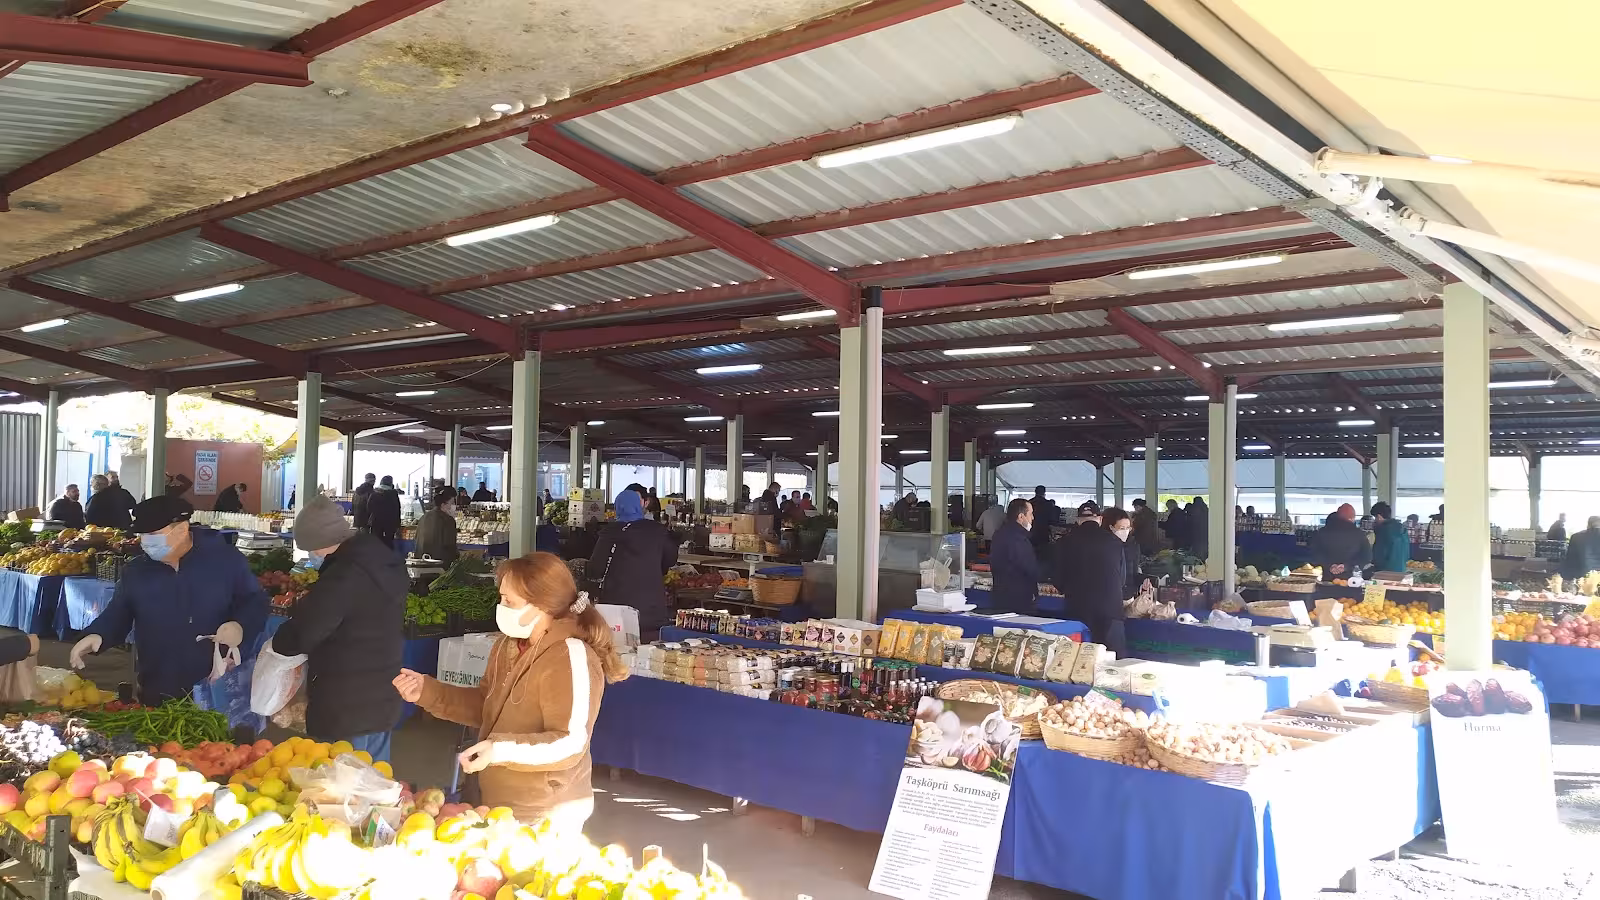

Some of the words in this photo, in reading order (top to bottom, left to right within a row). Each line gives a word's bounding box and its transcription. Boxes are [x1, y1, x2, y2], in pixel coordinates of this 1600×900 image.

[1464, 721, 1501, 732] Hurma
[906, 775, 949, 791] Taşköprü
[952, 783, 1001, 802] Sarımsağı
[923, 823, 959, 838] Faydaları
